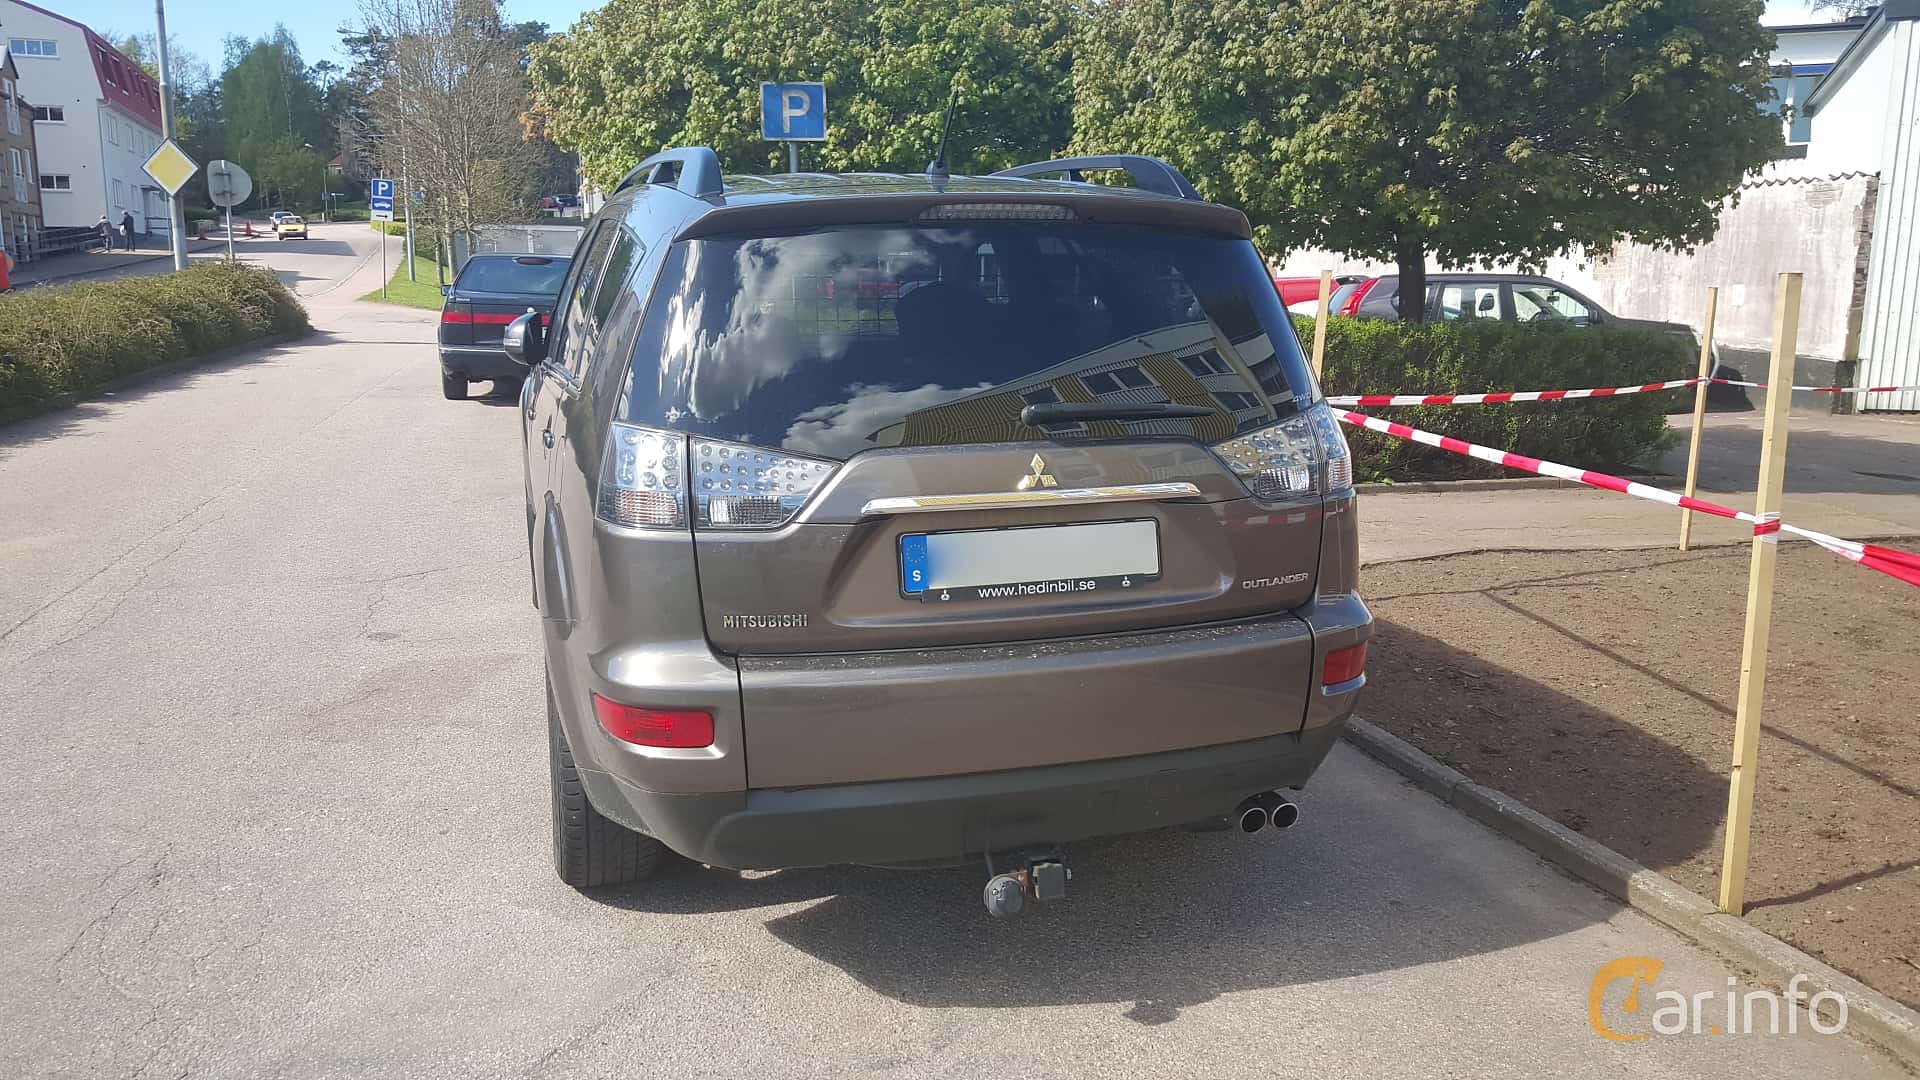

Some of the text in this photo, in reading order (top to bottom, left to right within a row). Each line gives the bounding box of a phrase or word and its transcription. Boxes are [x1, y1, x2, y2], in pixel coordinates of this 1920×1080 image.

[782, 89, 811, 134] P
[378, 181, 389, 196] P
[912, 569, 922, 582] S
[1242, 572, 1309, 590] OUTLANDER
[978, 578, 1096, 599] www.hedinbil.se
[723, 614, 808, 629] MITSUBISHI
